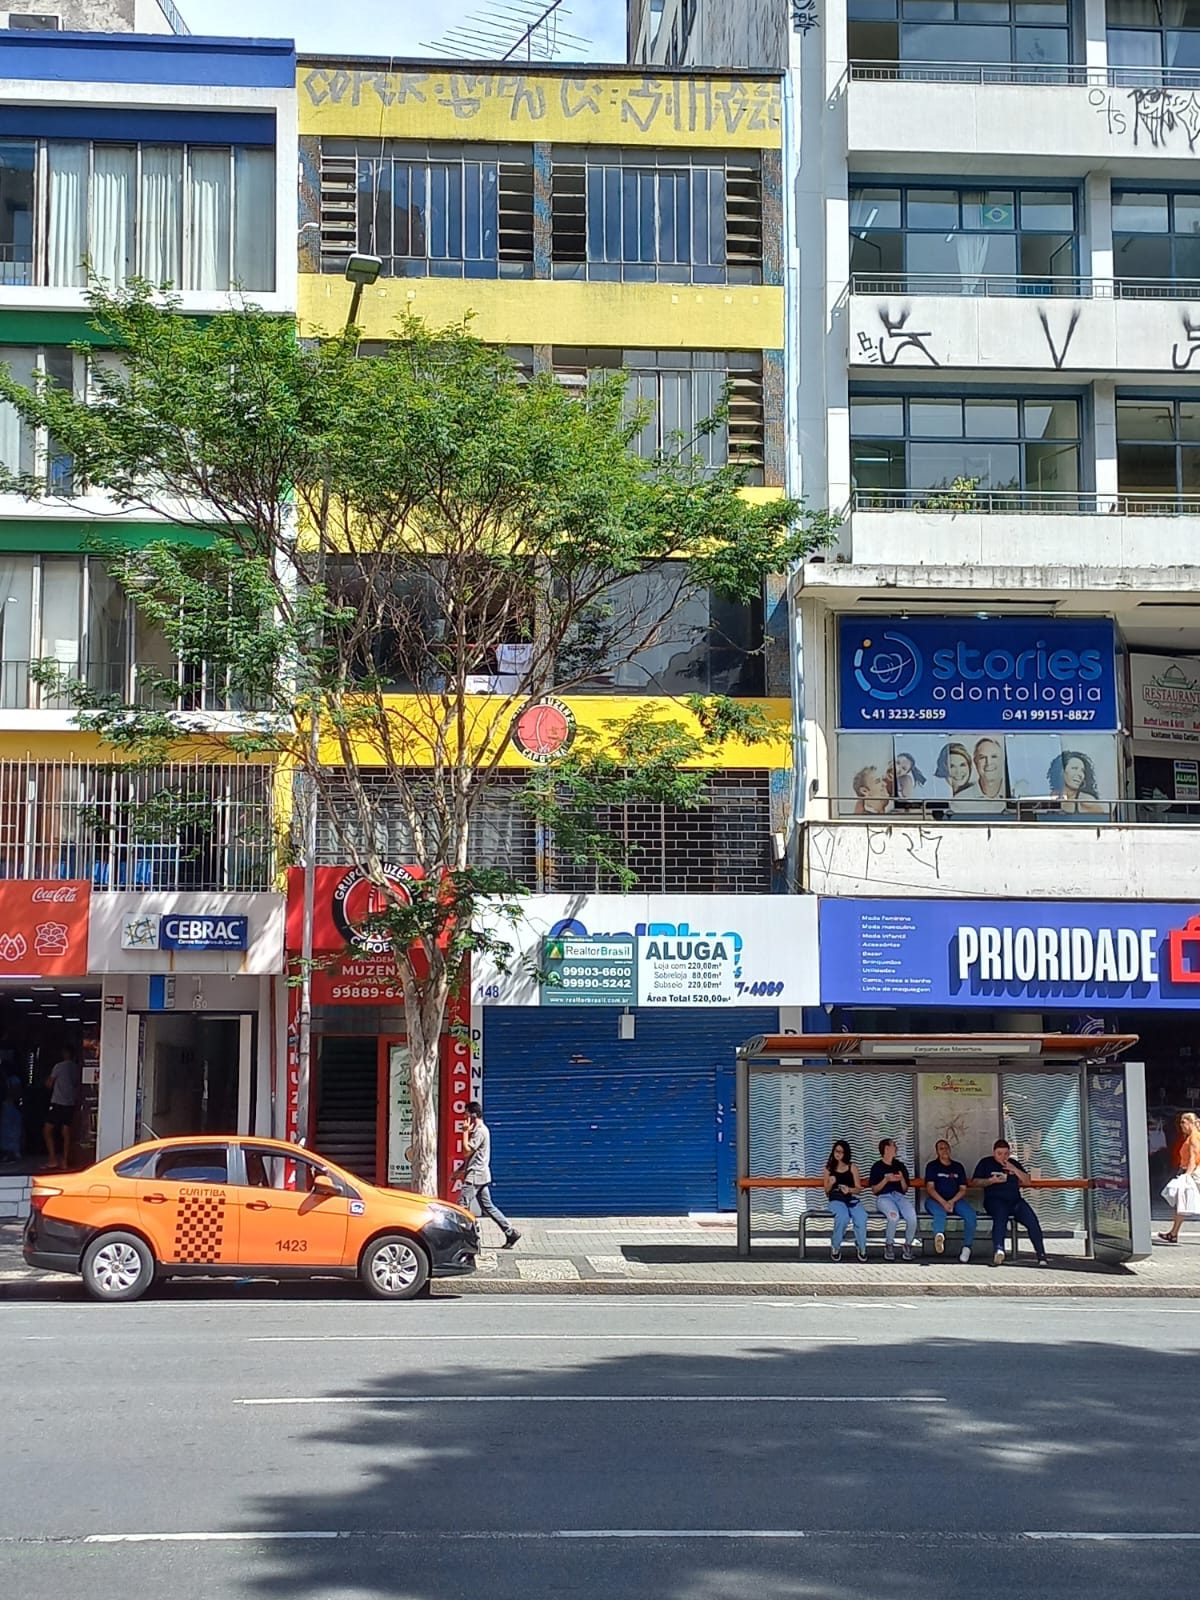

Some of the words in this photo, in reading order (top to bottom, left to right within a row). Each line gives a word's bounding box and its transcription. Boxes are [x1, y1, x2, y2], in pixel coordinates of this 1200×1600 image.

[932, 641, 1103, 681] stories
[932, 682, 1102, 706] odontologia
[872, 709, 885, 719] 41
[888, 708, 947, 720] 3232-5859
[1014, 709, 1027, 720] 41
[1030, 709, 1096, 721] 99151-8827
[165, 920, 241, 940] CEBRAC
[565, 945, 630, 956] RealtorBrasil
[645, 941, 729, 961] ALUGA
[957, 926, 1159, 983] PRIORIDADE
[563, 966, 631, 977] 99903-6600
[653, 962, 669, 971] Loja
[653, 971, 688, 980] Sobreloja
[563, 978, 631, 989] 99990-5242
[478, 985, 499, 998] 148
[669, 994, 691, 1002] Total
[179, 1187, 226, 1198] CURITIBA
[274, 1240, 308, 1253] 1423
